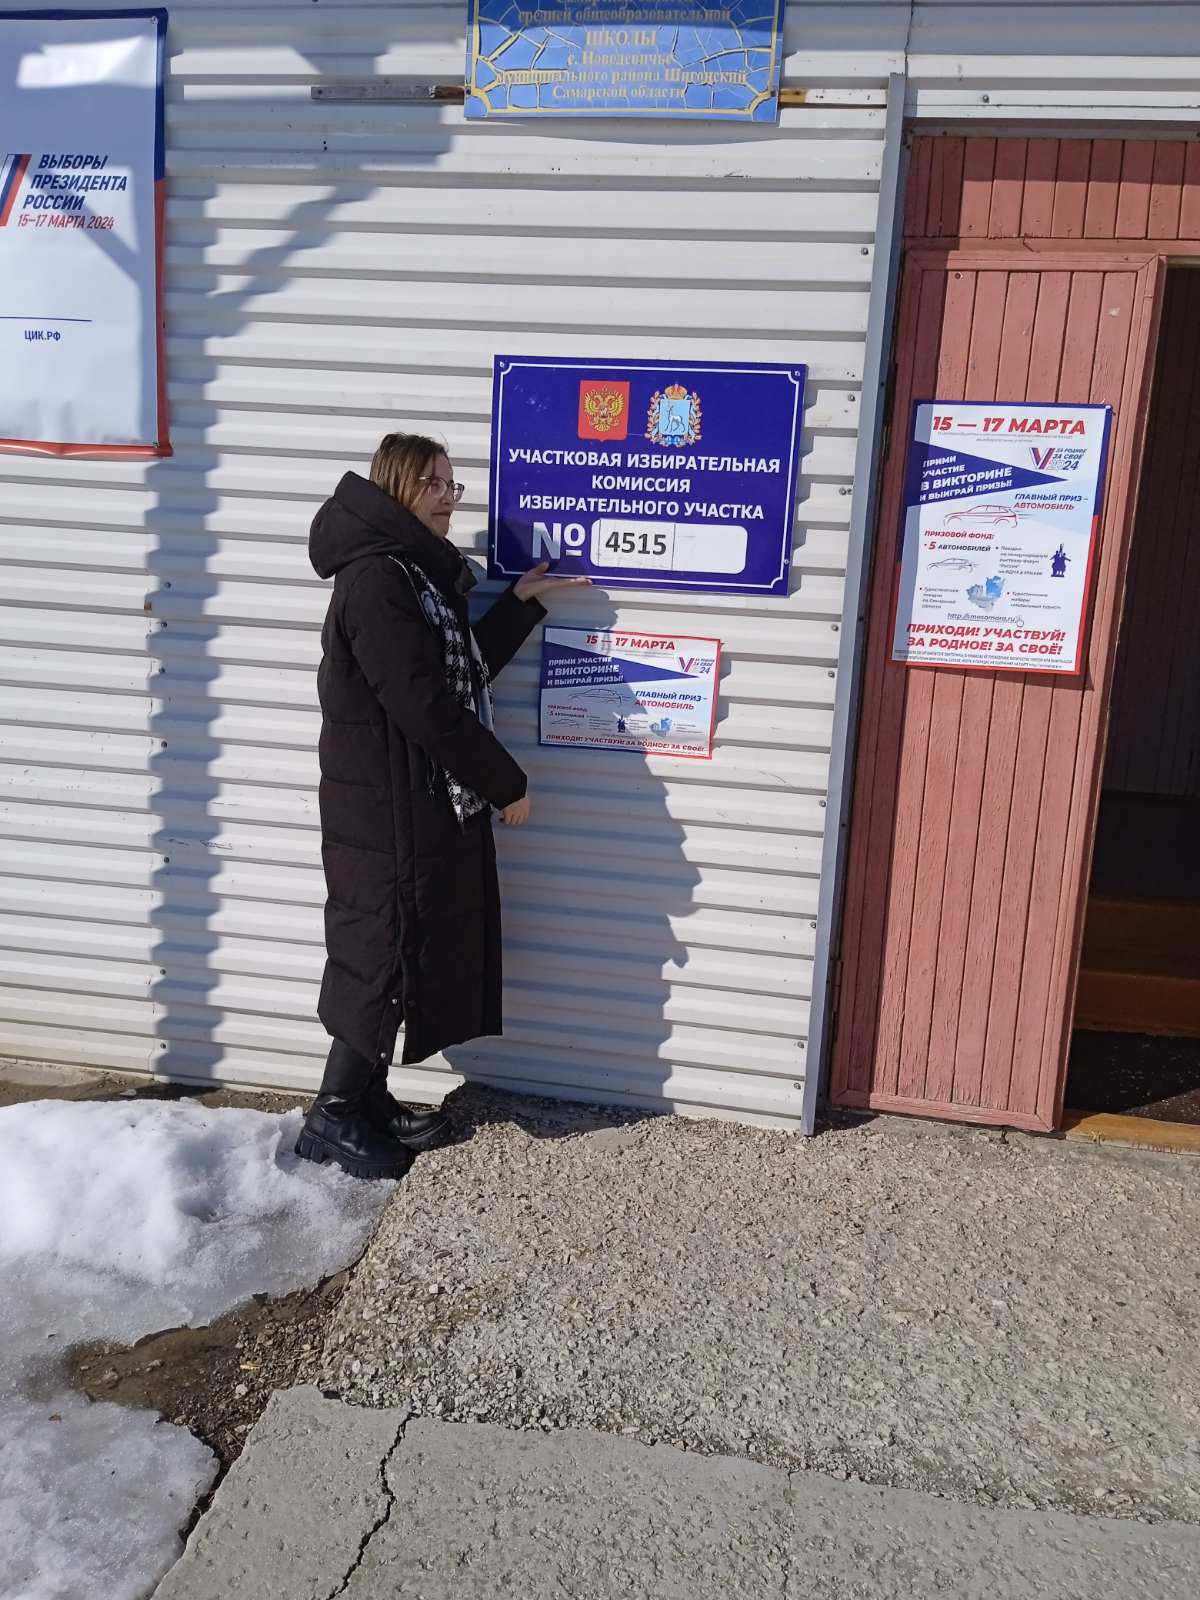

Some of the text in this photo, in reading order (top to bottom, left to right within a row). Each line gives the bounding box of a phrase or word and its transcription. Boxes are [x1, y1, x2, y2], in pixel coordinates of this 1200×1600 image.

[585, 30, 657, 47] ШКОЛЫ
[38, 154, 108, 170] ВЫБОРЫ
[30, 174, 128, 193] ПРЕЗИДЕНТА
[23, 194, 86, 211] РОССИИ
[48, 215, 85, 229] МАРТА
[87, 216, 115, 230] 2024
[24, 330, 61, 342] ЦИК.РФ
[932, 415, 953, 431] 15
[983, 417, 1004, 432] 17
[1008, 418, 1086, 435] МАРТА
[508, 448, 781, 474] УЧАСТКОВАЯ ИЗБИРАТЕЛЬНАЯ
[923, 455, 956, 468] ПРИМИ
[921, 467, 1013, 491] В ВИКТОРИНЕ
[923, 464, 965, 478] УЧАСТИЕ
[591, 475, 691, 493] КОМИССИЯ
[928, 486, 974, 501] ВЫИГРАЙ
[1014, 492, 1057, 502] ГЛАВНЫЙ
[1059, 494, 1082, 502] ПРИЗ
[519, 495, 764, 520] ИЗБИРАТЕЛЬНОГО УЧАСТКА
[1013, 502, 1075, 511] АВТОМОБИЛЬ
[532, 521, 667, 560] № 4515
[924, 531, 995, 540] ПРИЗОВОЙ ФОНД:
[928, 541, 936, 550] 5
[937, 544, 991, 552] АВТОМОБИЛЕЙ
[906, 623, 1066, 642] ПРИХОДИ! УЧАСТВУЙ!
[586, 633, 598, 645] 15
[615, 637, 628, 647] 17
[630, 638, 676, 651] МАРТА
[906, 637, 1062, 655] ЗА РОДНОЕ! ЗА СВОЁ!
[555, 664, 620, 677] ВИКТОРИНЕ
[635, 690, 677, 700] ГЛАВНЫЙ
[678, 693, 702, 702] ПРИЗ
[634, 699, 695, 711] АВТОМОБИЛЬ
